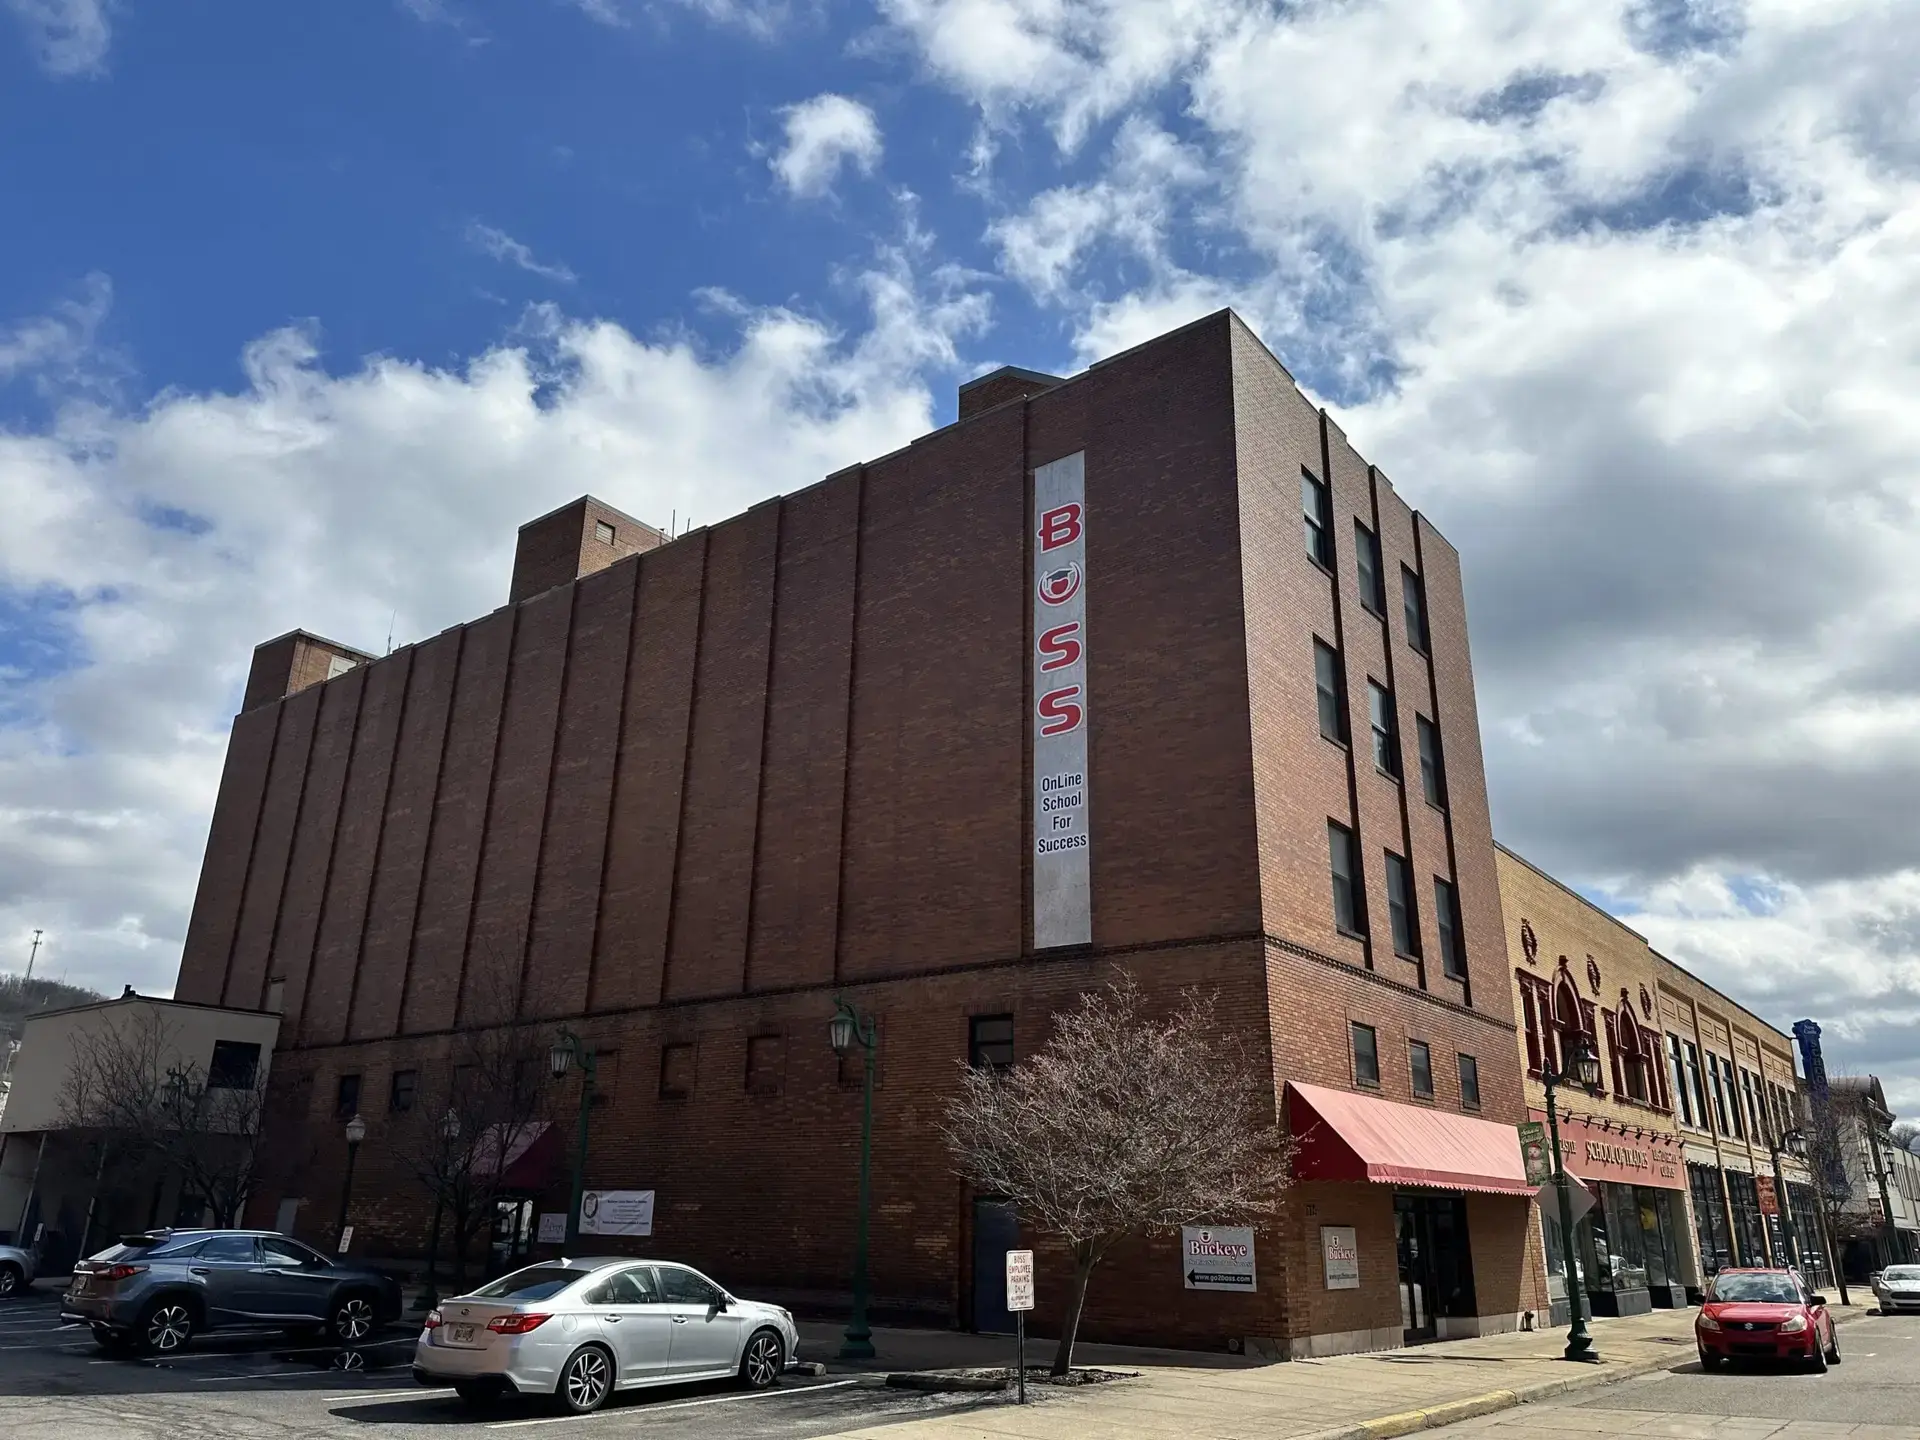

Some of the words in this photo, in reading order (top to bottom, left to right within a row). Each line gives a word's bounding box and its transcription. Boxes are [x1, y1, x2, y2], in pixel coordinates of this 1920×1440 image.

[1042, 773, 1082, 792] OnLine
[1042, 791, 1082, 811] School
[1052, 816, 1071, 830] For
[1038, 834, 1087, 853] Success
[1585, 1140, 1614, 1164] SCHOOL
[1189, 1240, 1247, 1261] Buckeye
[1328, 1245, 1355, 1263] Buckeye
[1008, 1264, 1031, 1274] EMPLOYEE
